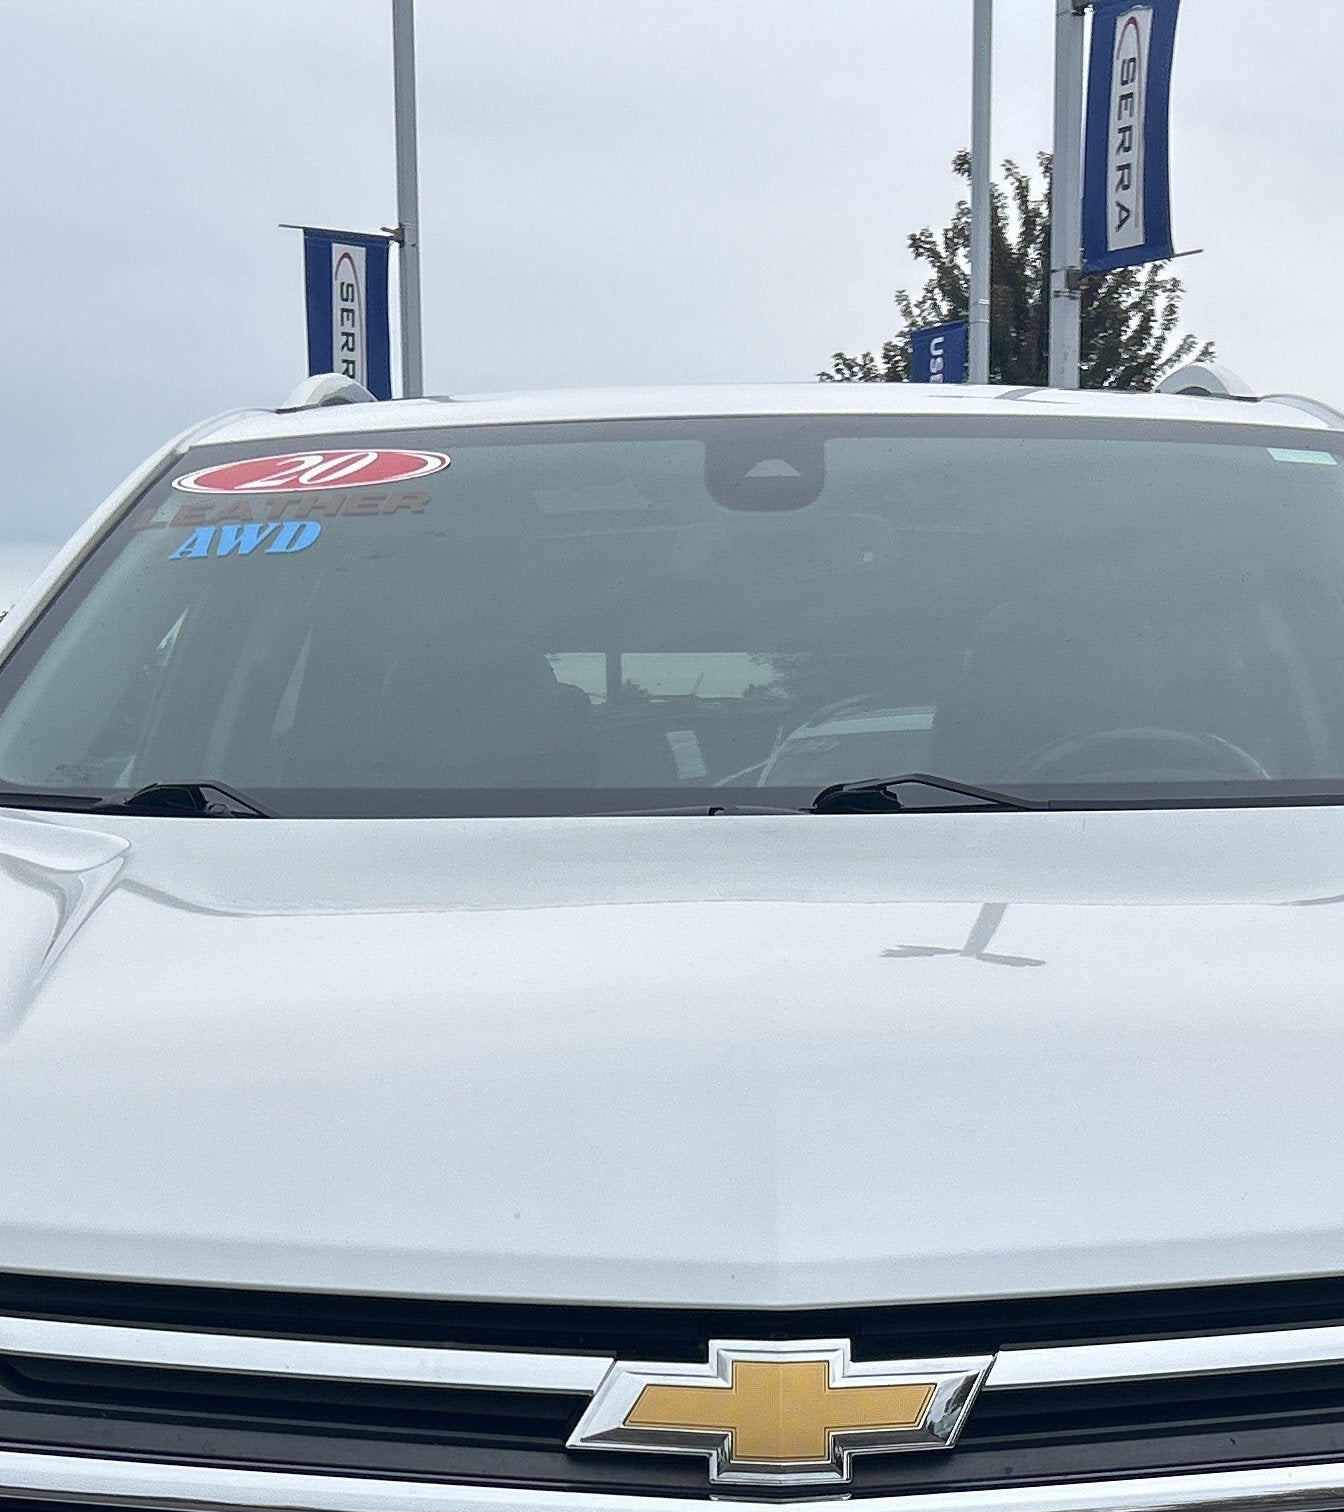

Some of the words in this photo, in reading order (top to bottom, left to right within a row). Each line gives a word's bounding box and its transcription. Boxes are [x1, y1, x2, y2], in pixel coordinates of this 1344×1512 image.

[1114, 56, 1136, 233] SERRA
[233, 450, 379, 490] 20
[131, 490, 432, 531] LEATHER
[167, 519, 322, 560] AWD
